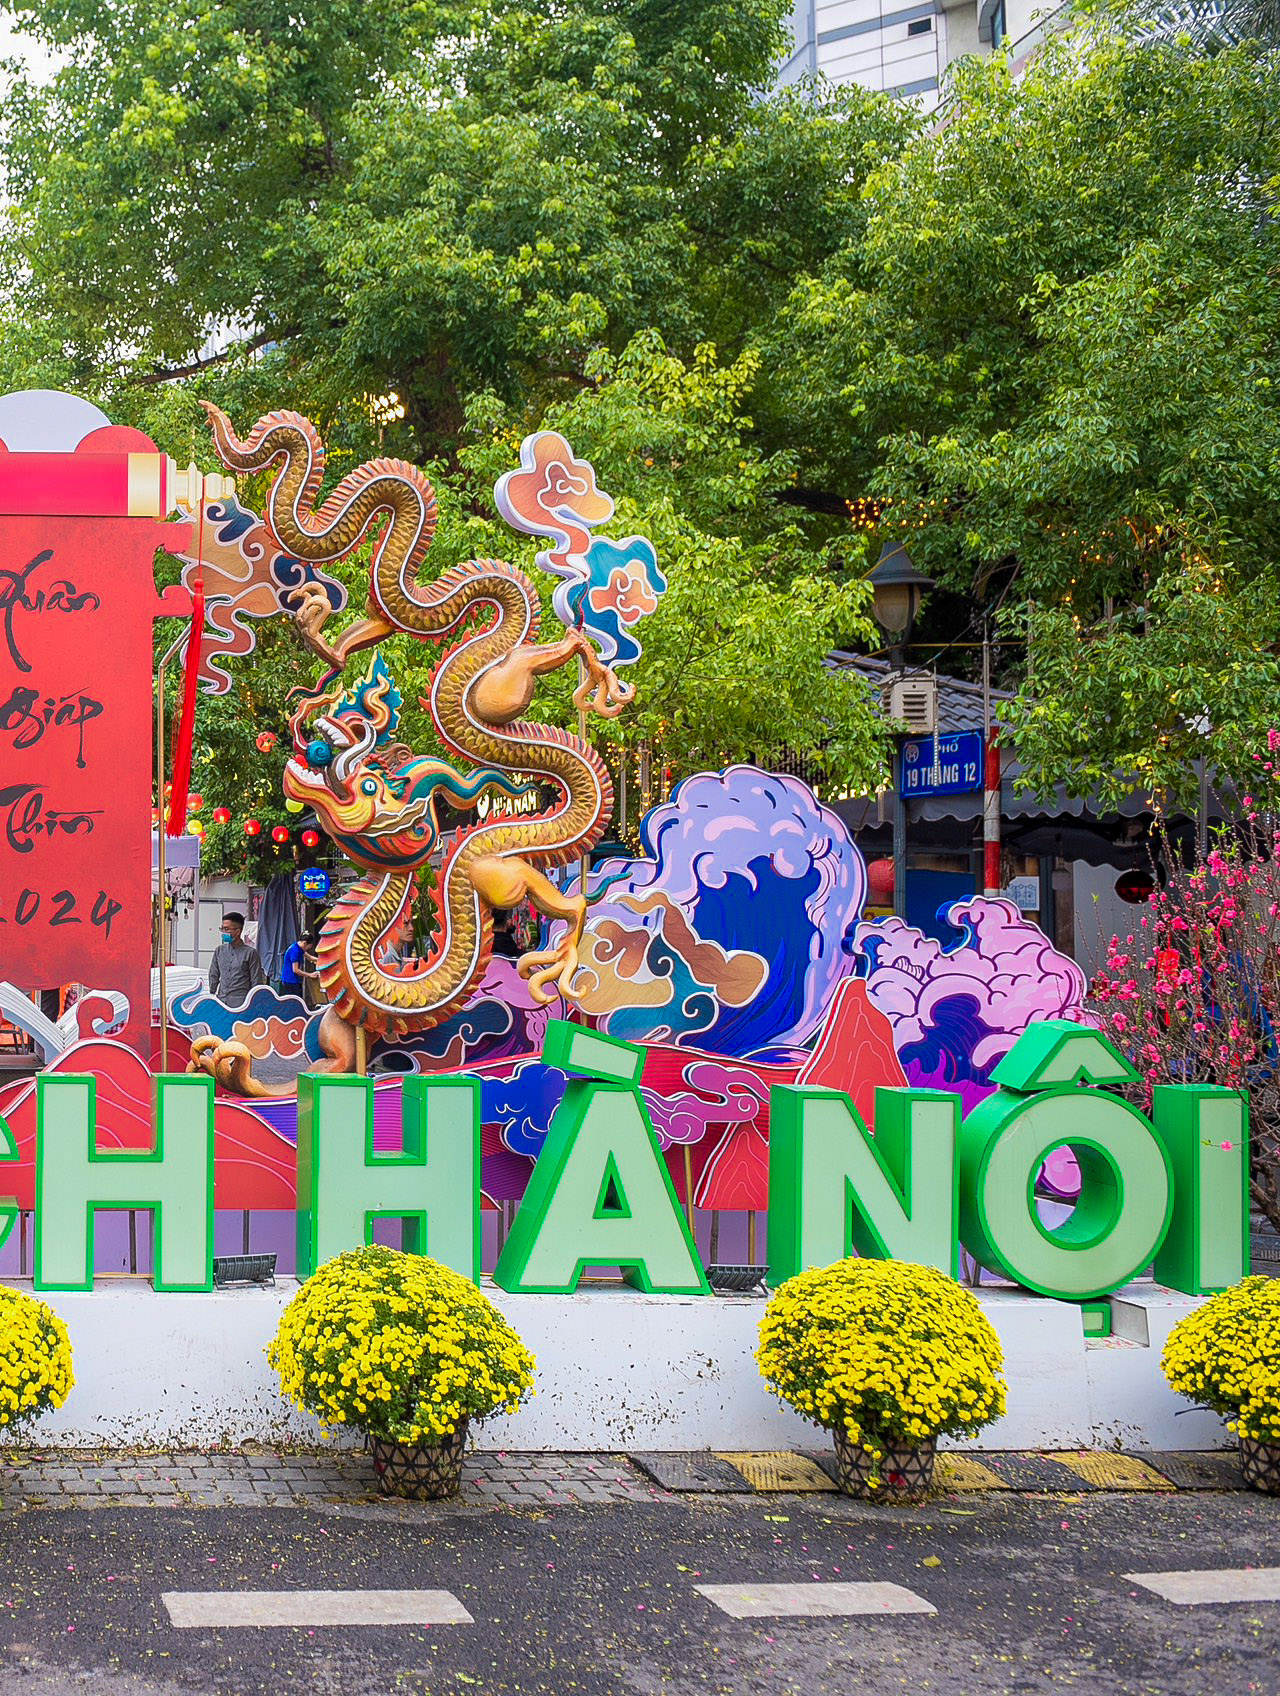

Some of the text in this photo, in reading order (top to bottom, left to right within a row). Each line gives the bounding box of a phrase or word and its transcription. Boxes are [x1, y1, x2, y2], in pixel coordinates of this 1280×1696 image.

[906, 768, 919, 788] 19
[964, 762, 977, 783] 12
[296, 1018, 712, 1296] HÀ
[767, 1019, 1251, 1338] NỘI
